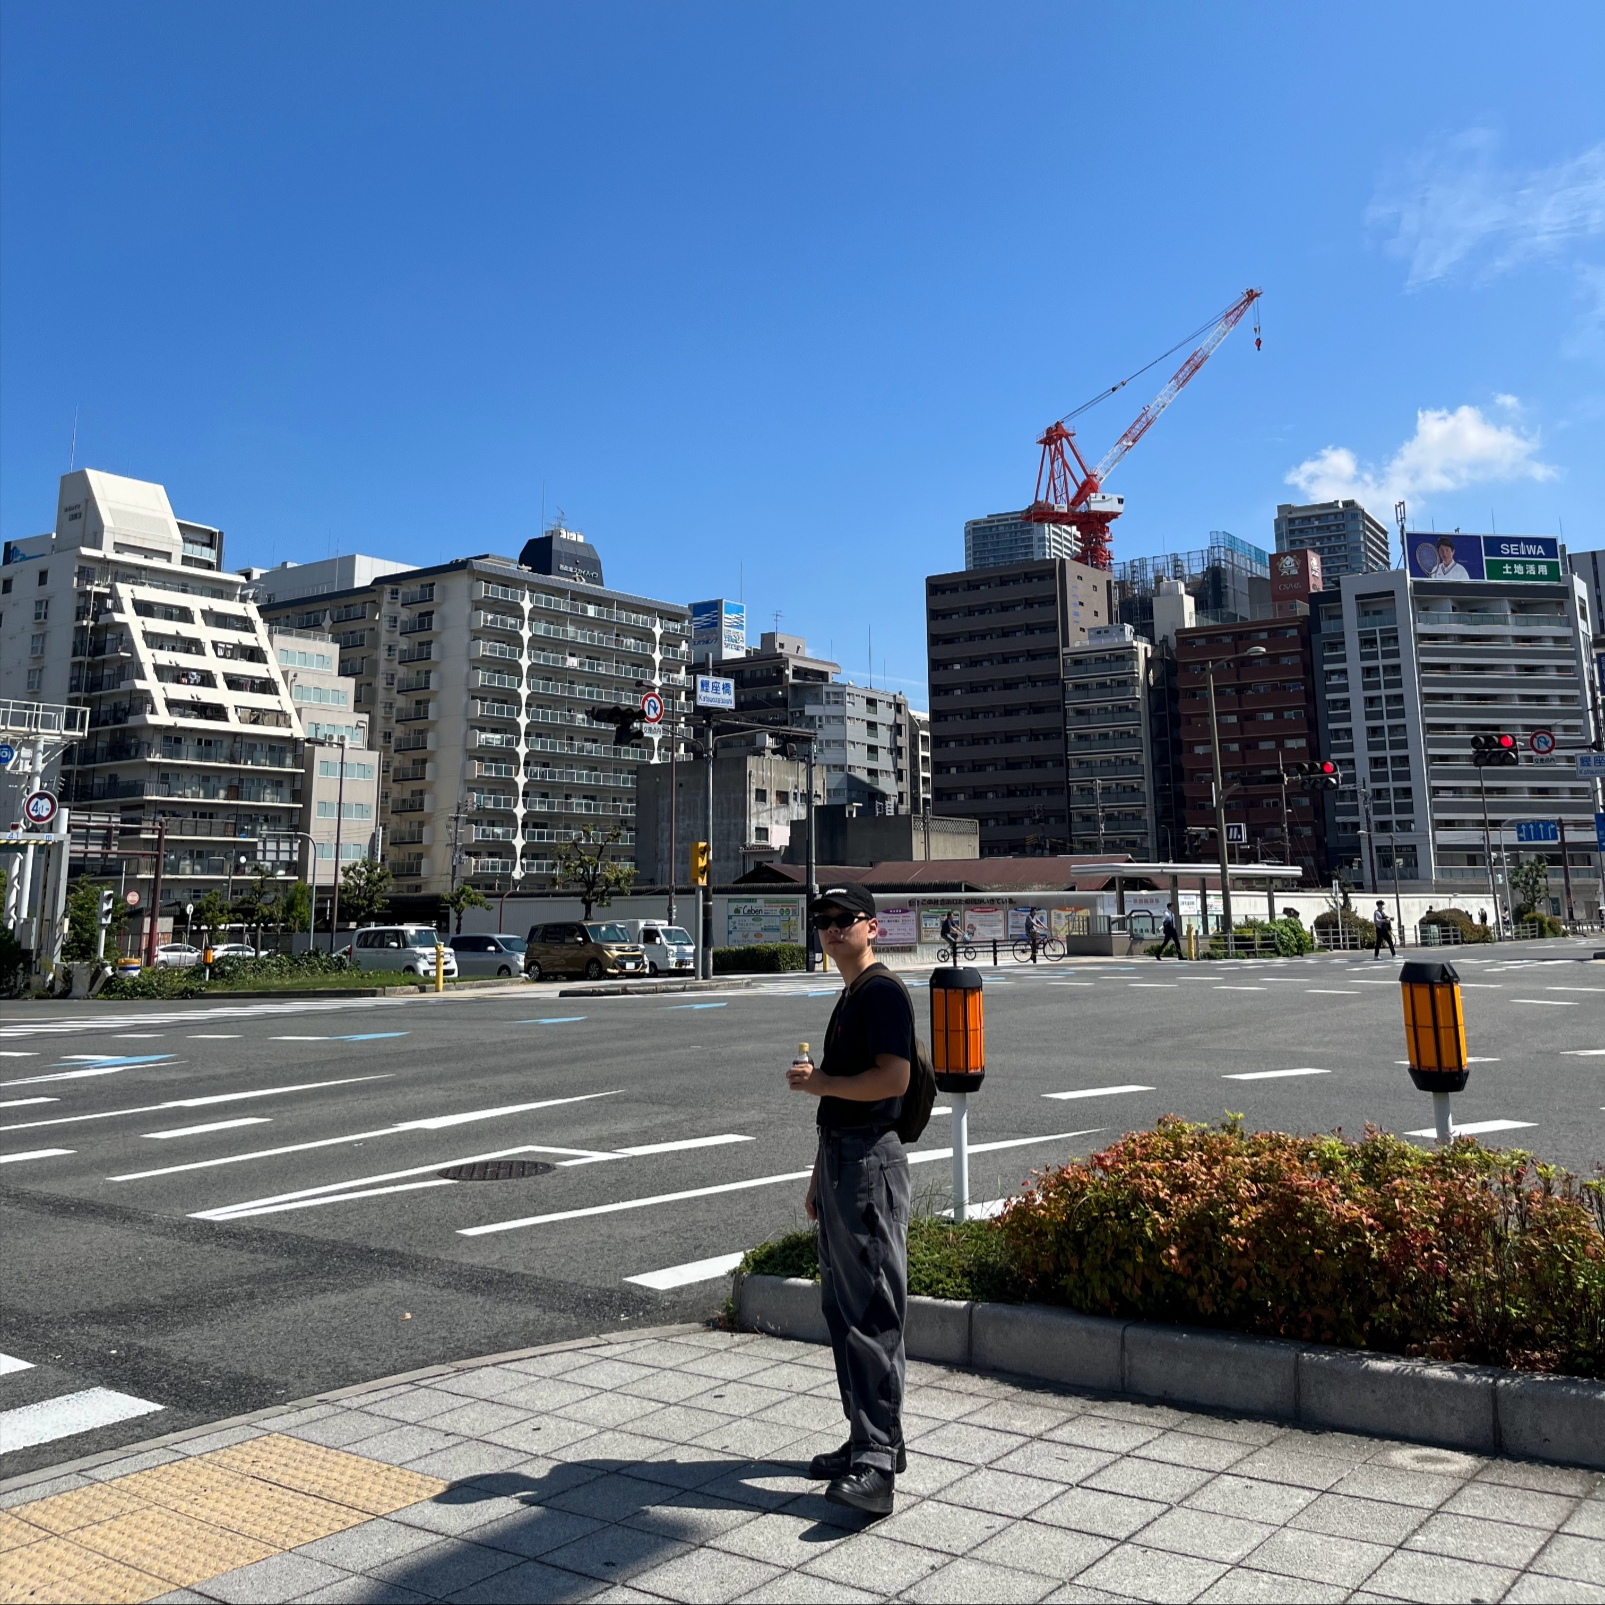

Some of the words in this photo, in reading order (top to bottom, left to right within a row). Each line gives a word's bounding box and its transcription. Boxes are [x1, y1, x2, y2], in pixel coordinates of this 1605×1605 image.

[1500, 541, 1546, 556] SEIWA
[1502, 563, 1548, 575] 土地活用
